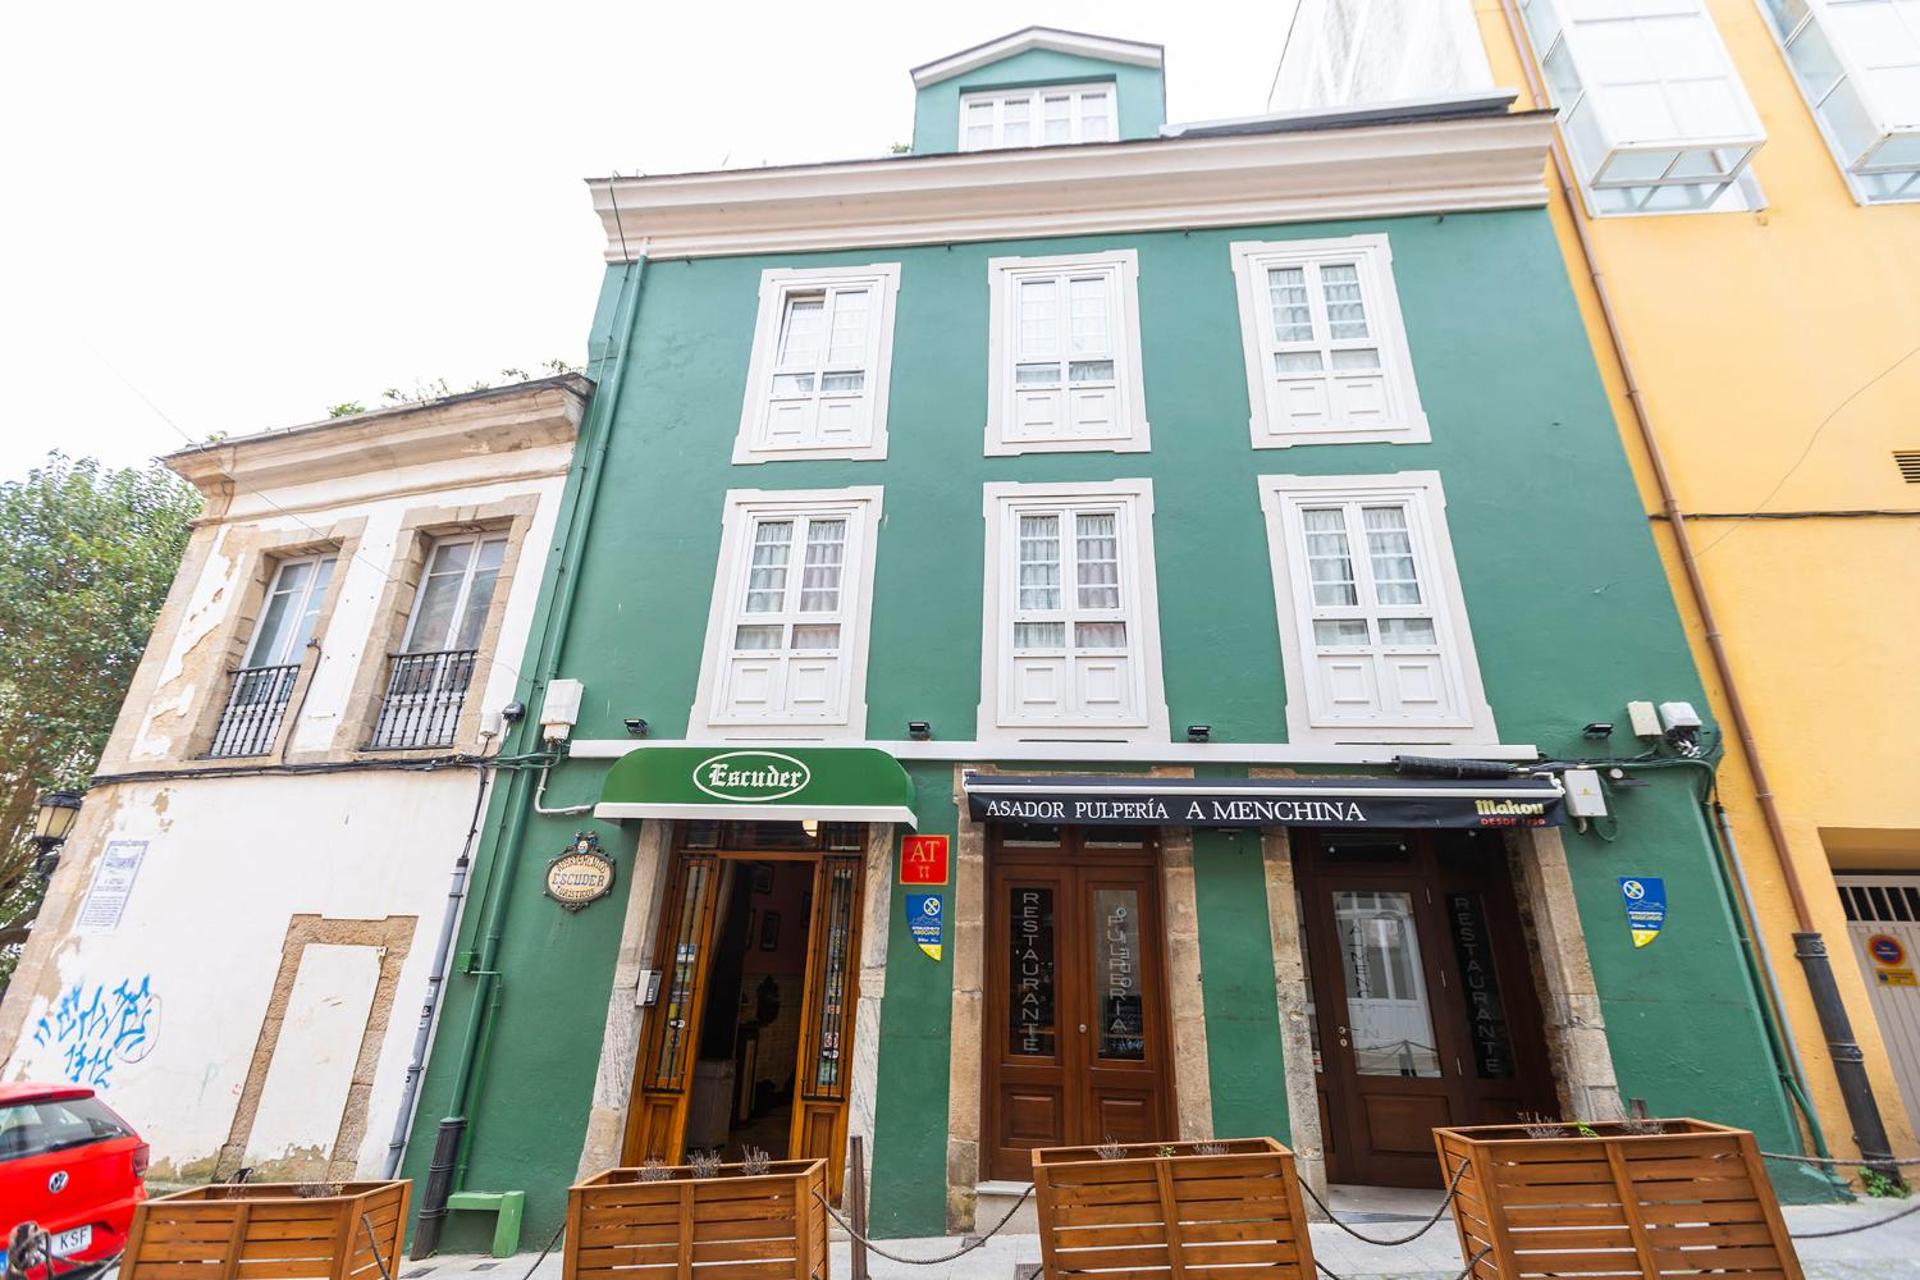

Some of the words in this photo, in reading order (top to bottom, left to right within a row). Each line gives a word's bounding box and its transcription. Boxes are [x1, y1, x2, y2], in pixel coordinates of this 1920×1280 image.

[709, 763, 802, 788] Escuder
[985, 800, 1066, 819] ASADOR
[1074, 798, 1170, 820] PULPERÍA
[1185, 801, 1206, 820] A
[1212, 801, 1367, 822] MENCHINA
[910, 841, 940, 863] AT
[552, 872, 605, 888] ESCUDER
[1022, 892, 1040, 1051] RESTAURANTE
[1455, 897, 1503, 1072] RESTAURANTE
[60, 1227, 88, 1250] KSF
